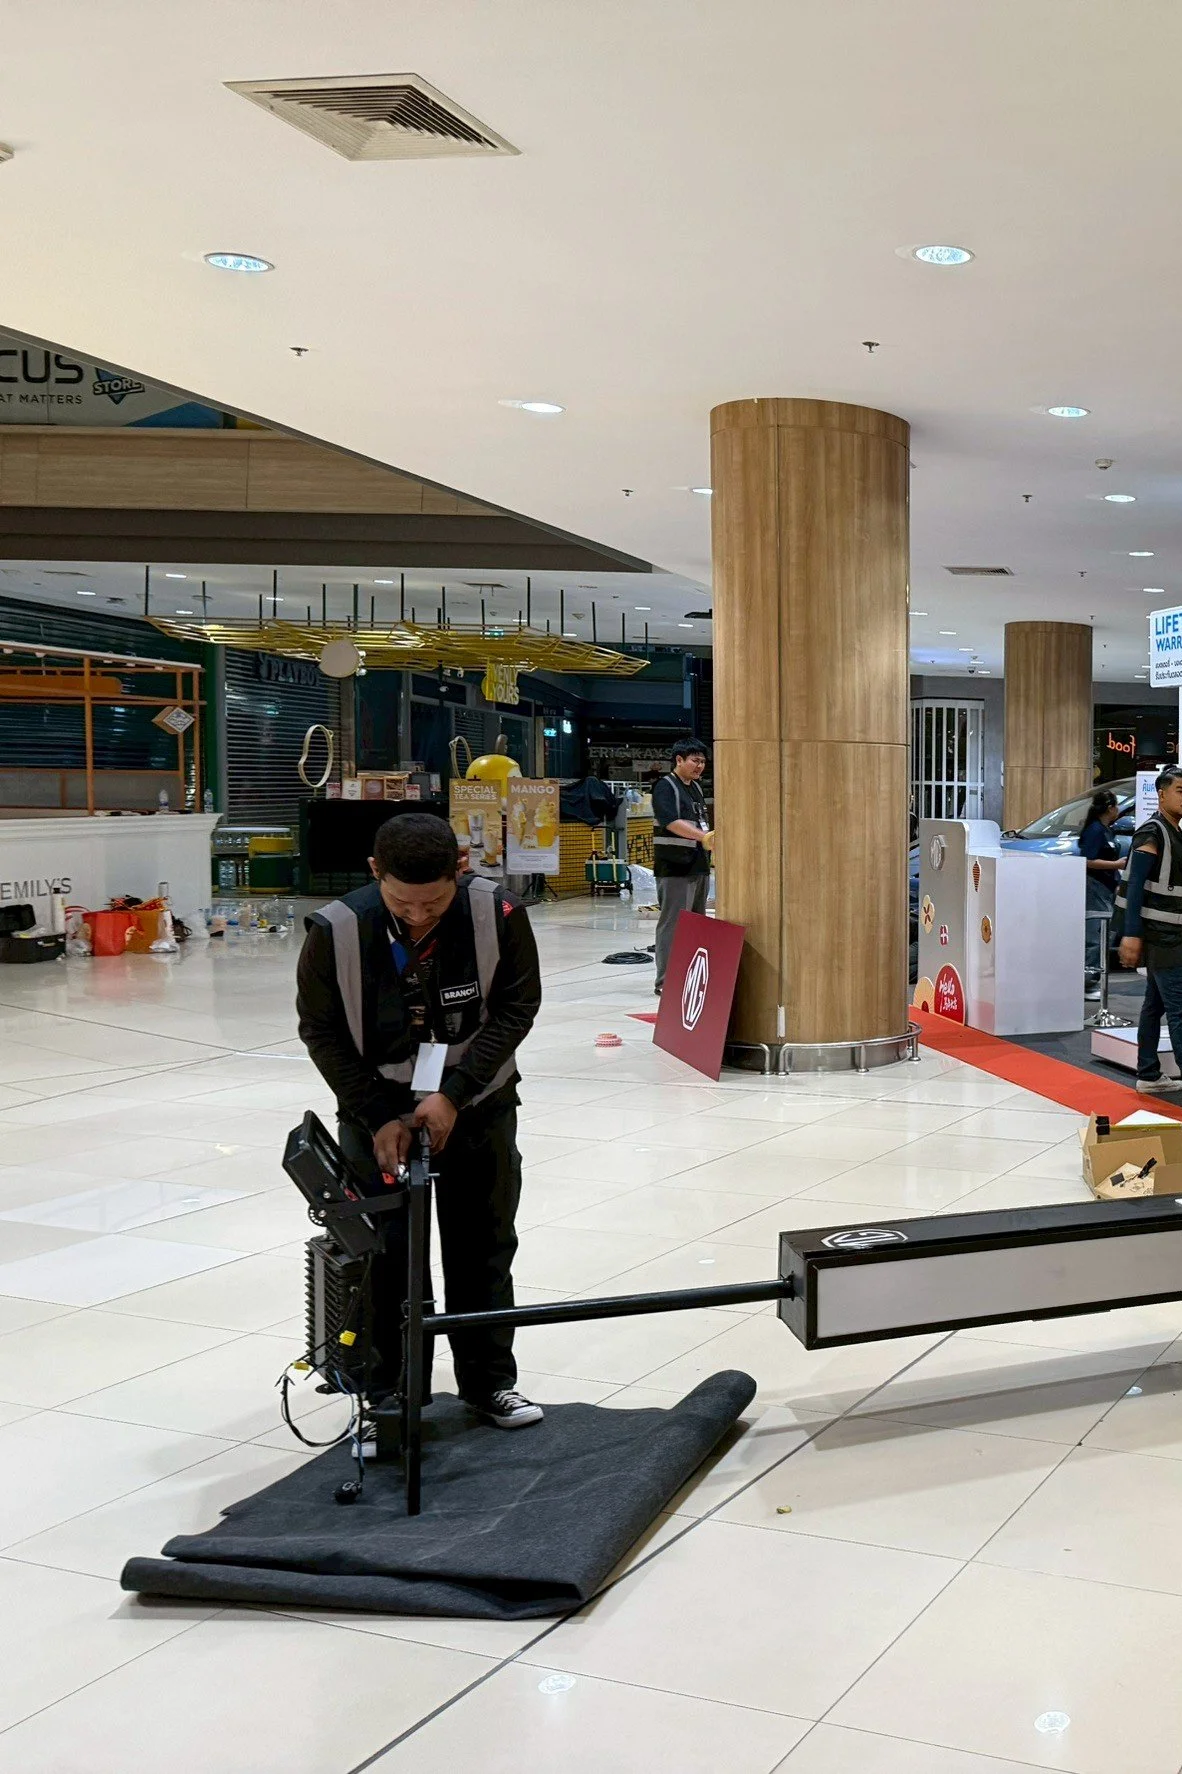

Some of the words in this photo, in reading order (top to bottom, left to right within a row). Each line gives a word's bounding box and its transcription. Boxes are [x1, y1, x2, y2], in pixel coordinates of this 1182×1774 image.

[19, 394, 82, 405] MATTERS
[454, 785, 497, 794] SPECIAL
[511, 785, 555, 794] MANGO
[0, 877, 72, 900] EMILY'S
[444, 987, 475, 999] BRANCH
[683, 952, 707, 1026] MG
